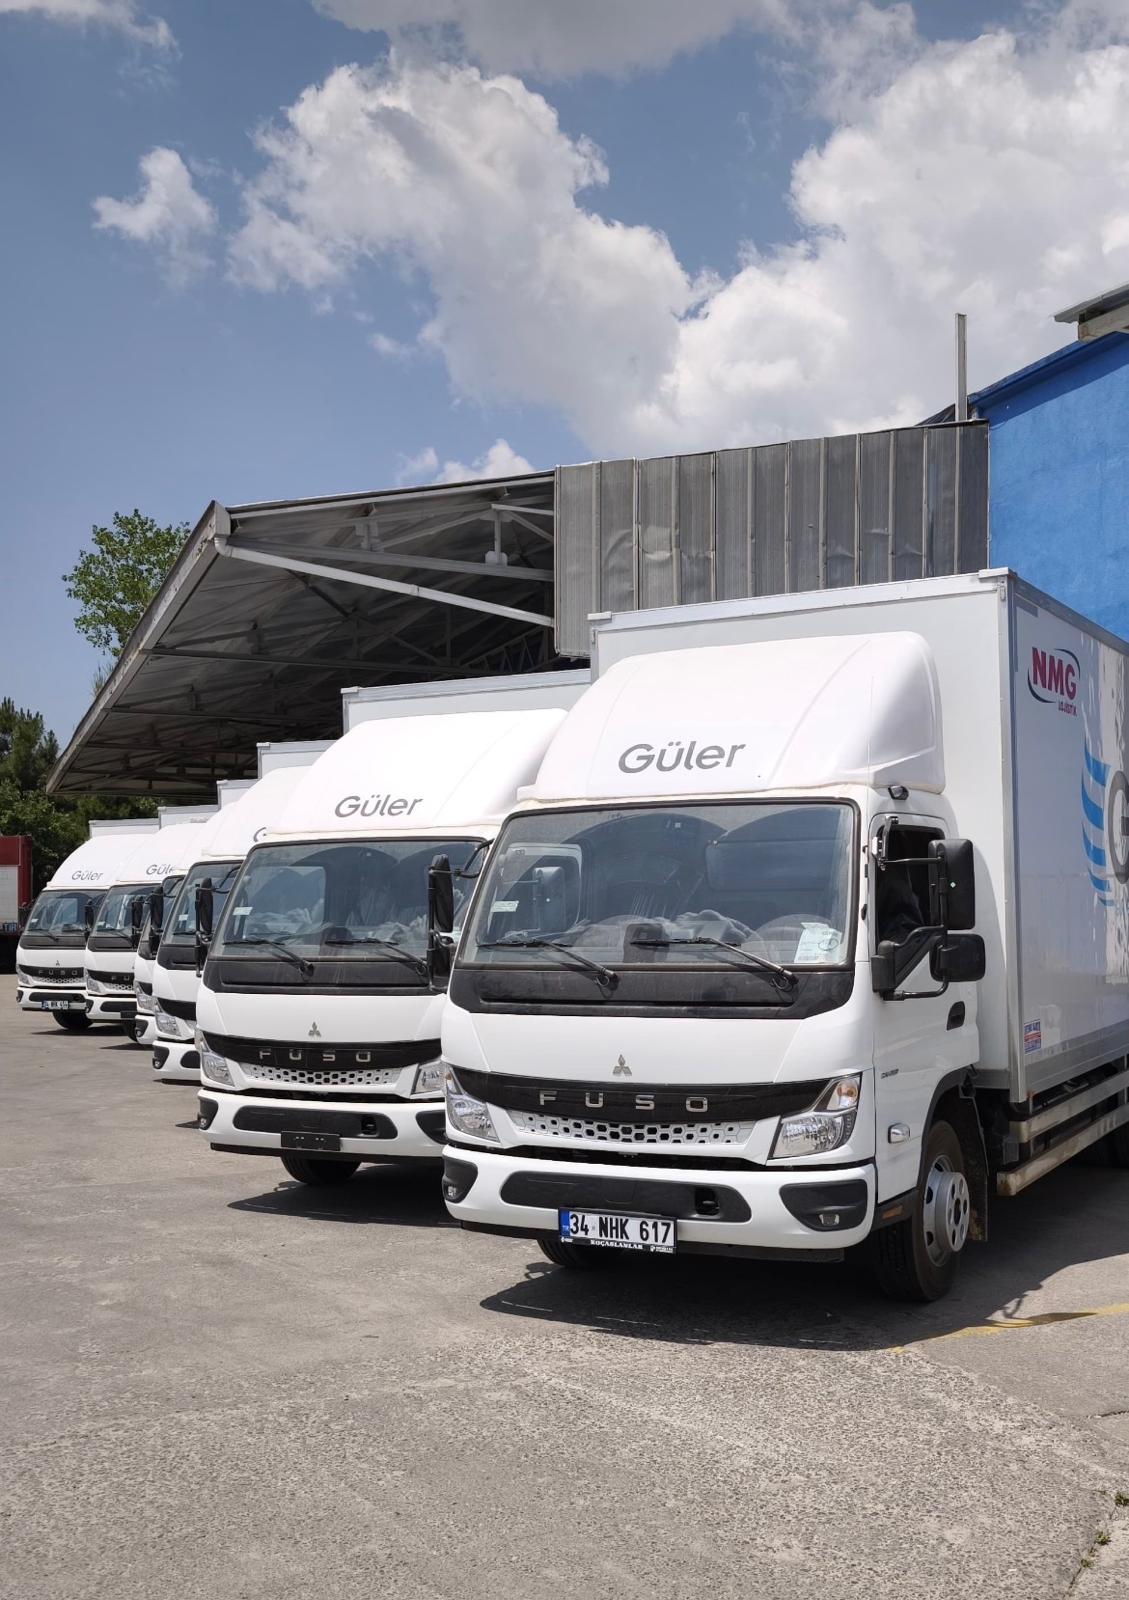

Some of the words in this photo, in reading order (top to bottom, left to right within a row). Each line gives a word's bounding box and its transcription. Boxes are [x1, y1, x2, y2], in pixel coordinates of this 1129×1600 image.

[1031, 646, 1077, 701] NMG
[618, 740, 747, 774] Güler
[334, 794, 423, 818] Güler
[71, 870, 104, 882] Güler
[146, 863, 173, 876] Gül
[259, 1048, 371, 1063] FUSO
[539, 1090, 708, 1113] FUSO
[569, 1213, 589, 1236] 34
[598, 1216, 630, 1240] NHK
[639, 1220, 671, 1244] 617
